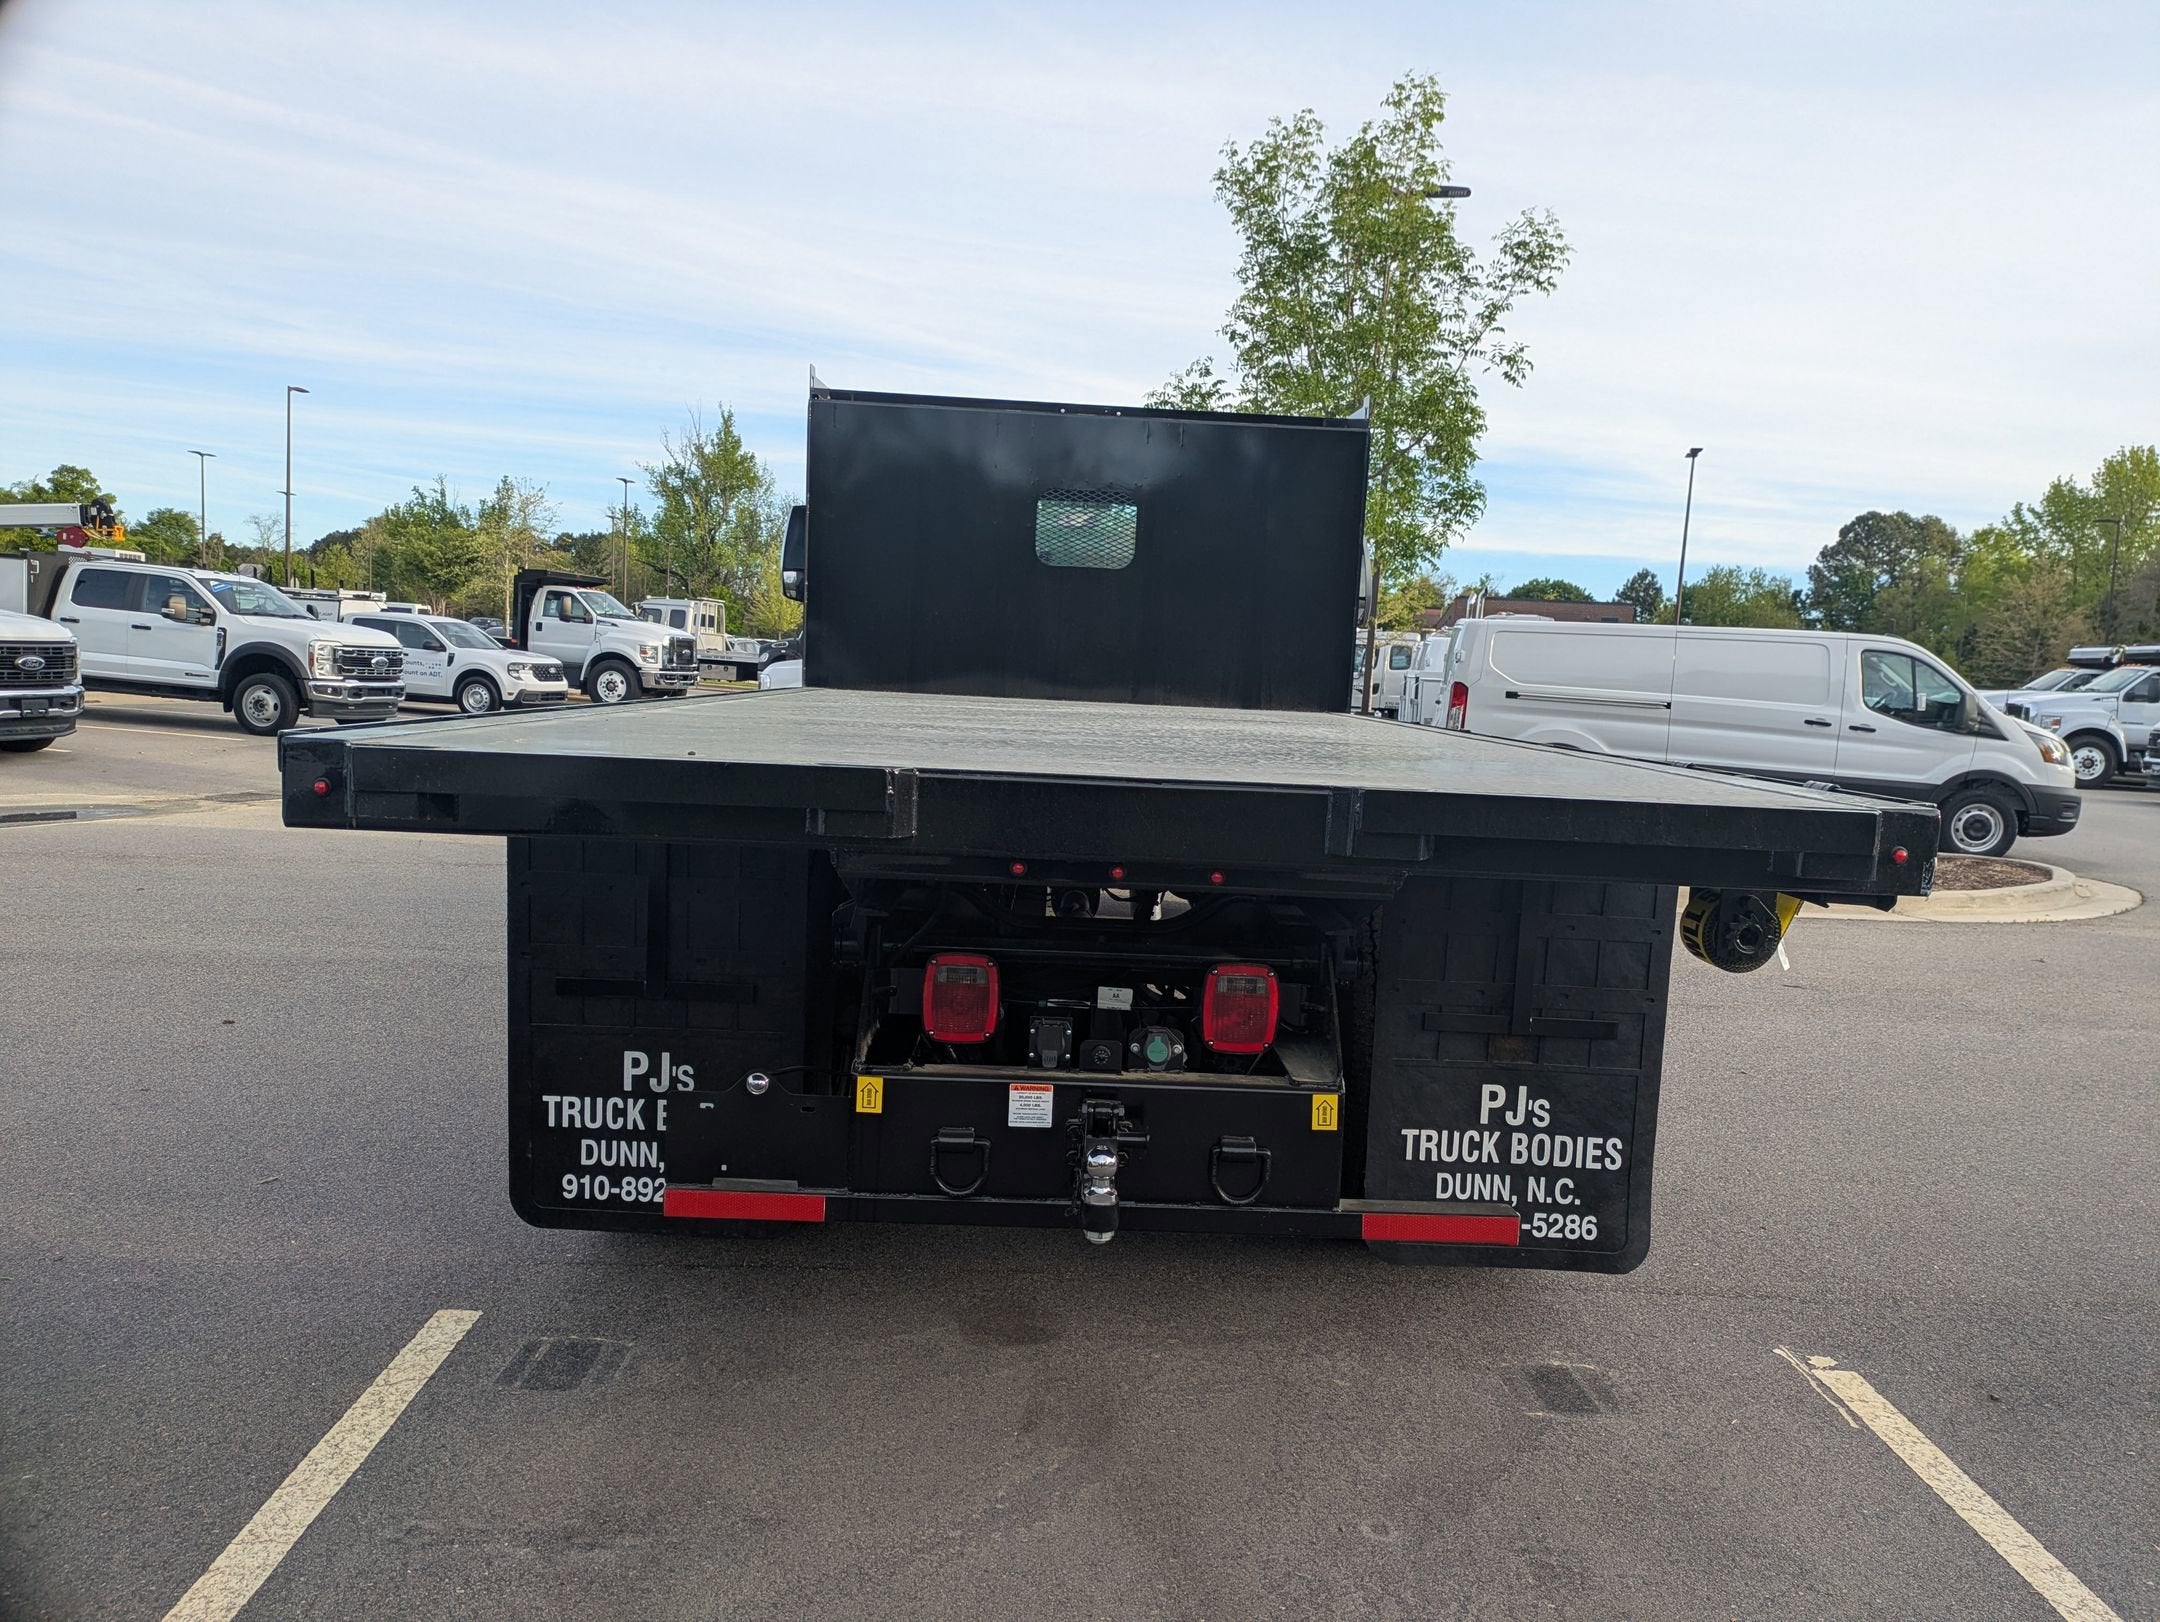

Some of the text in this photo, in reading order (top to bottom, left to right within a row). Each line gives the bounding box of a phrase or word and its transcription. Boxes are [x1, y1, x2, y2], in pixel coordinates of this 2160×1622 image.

[542, 1095, 646, 1131] TRUCK
[580, 1139, 665, 1174] DUNN,
[1401, 1128, 1623, 1171] TRUCK BODIES
[1435, 1172, 1581, 1207] DUNN, N.C.
